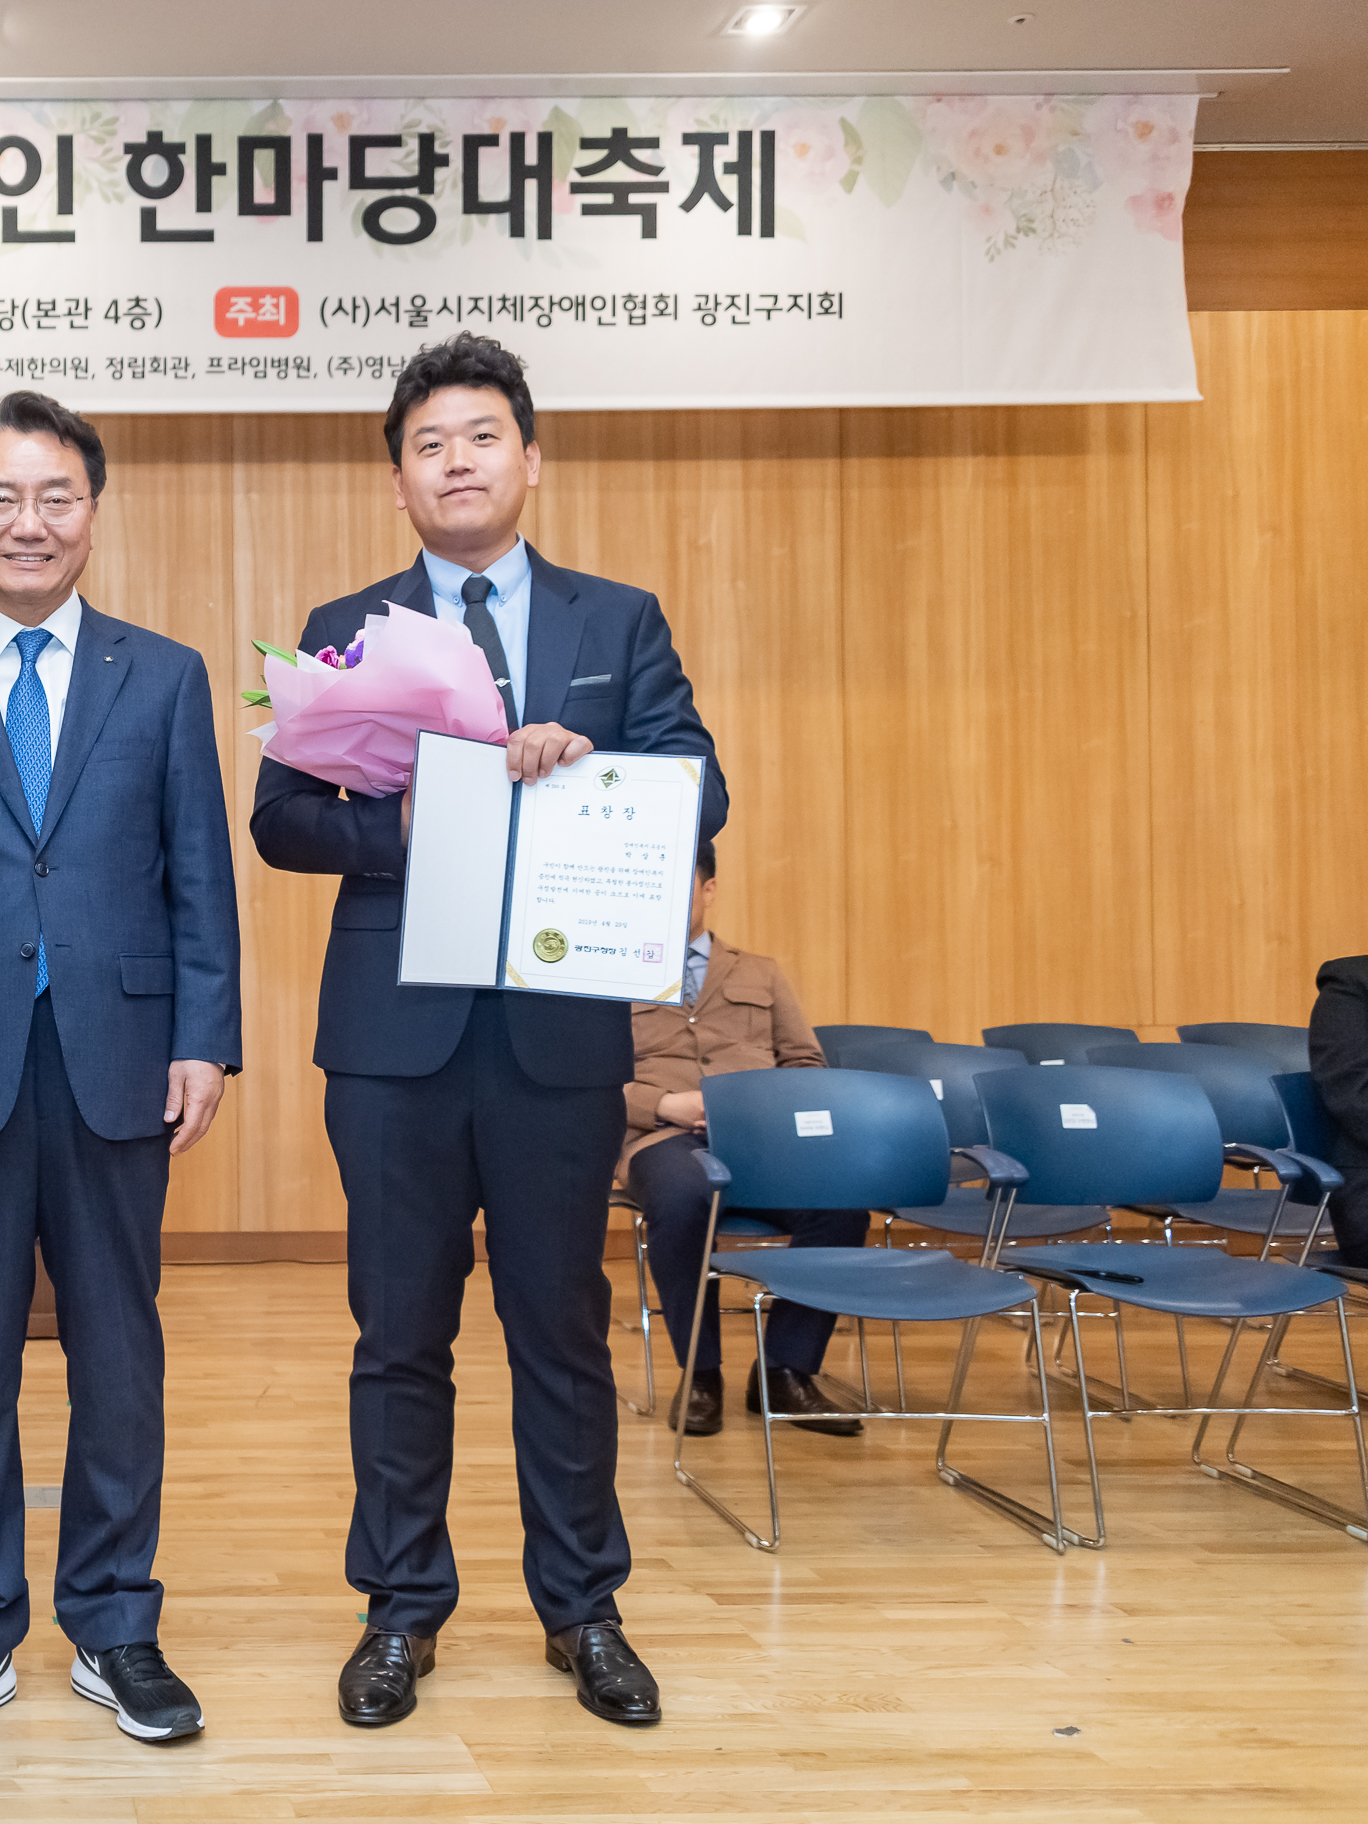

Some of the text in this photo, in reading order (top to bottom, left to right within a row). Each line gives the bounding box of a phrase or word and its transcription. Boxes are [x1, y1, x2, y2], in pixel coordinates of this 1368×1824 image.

[123, 127, 776, 246] 한마당대축제
[104, 296, 163, 330] 4층)
[226, 291, 844, 328] 주최 (사)서울시지체장애인협회 광진구지회
[105, 356, 197, 381] 정립회관,
[205, 356, 318, 381] 프라임병원,
